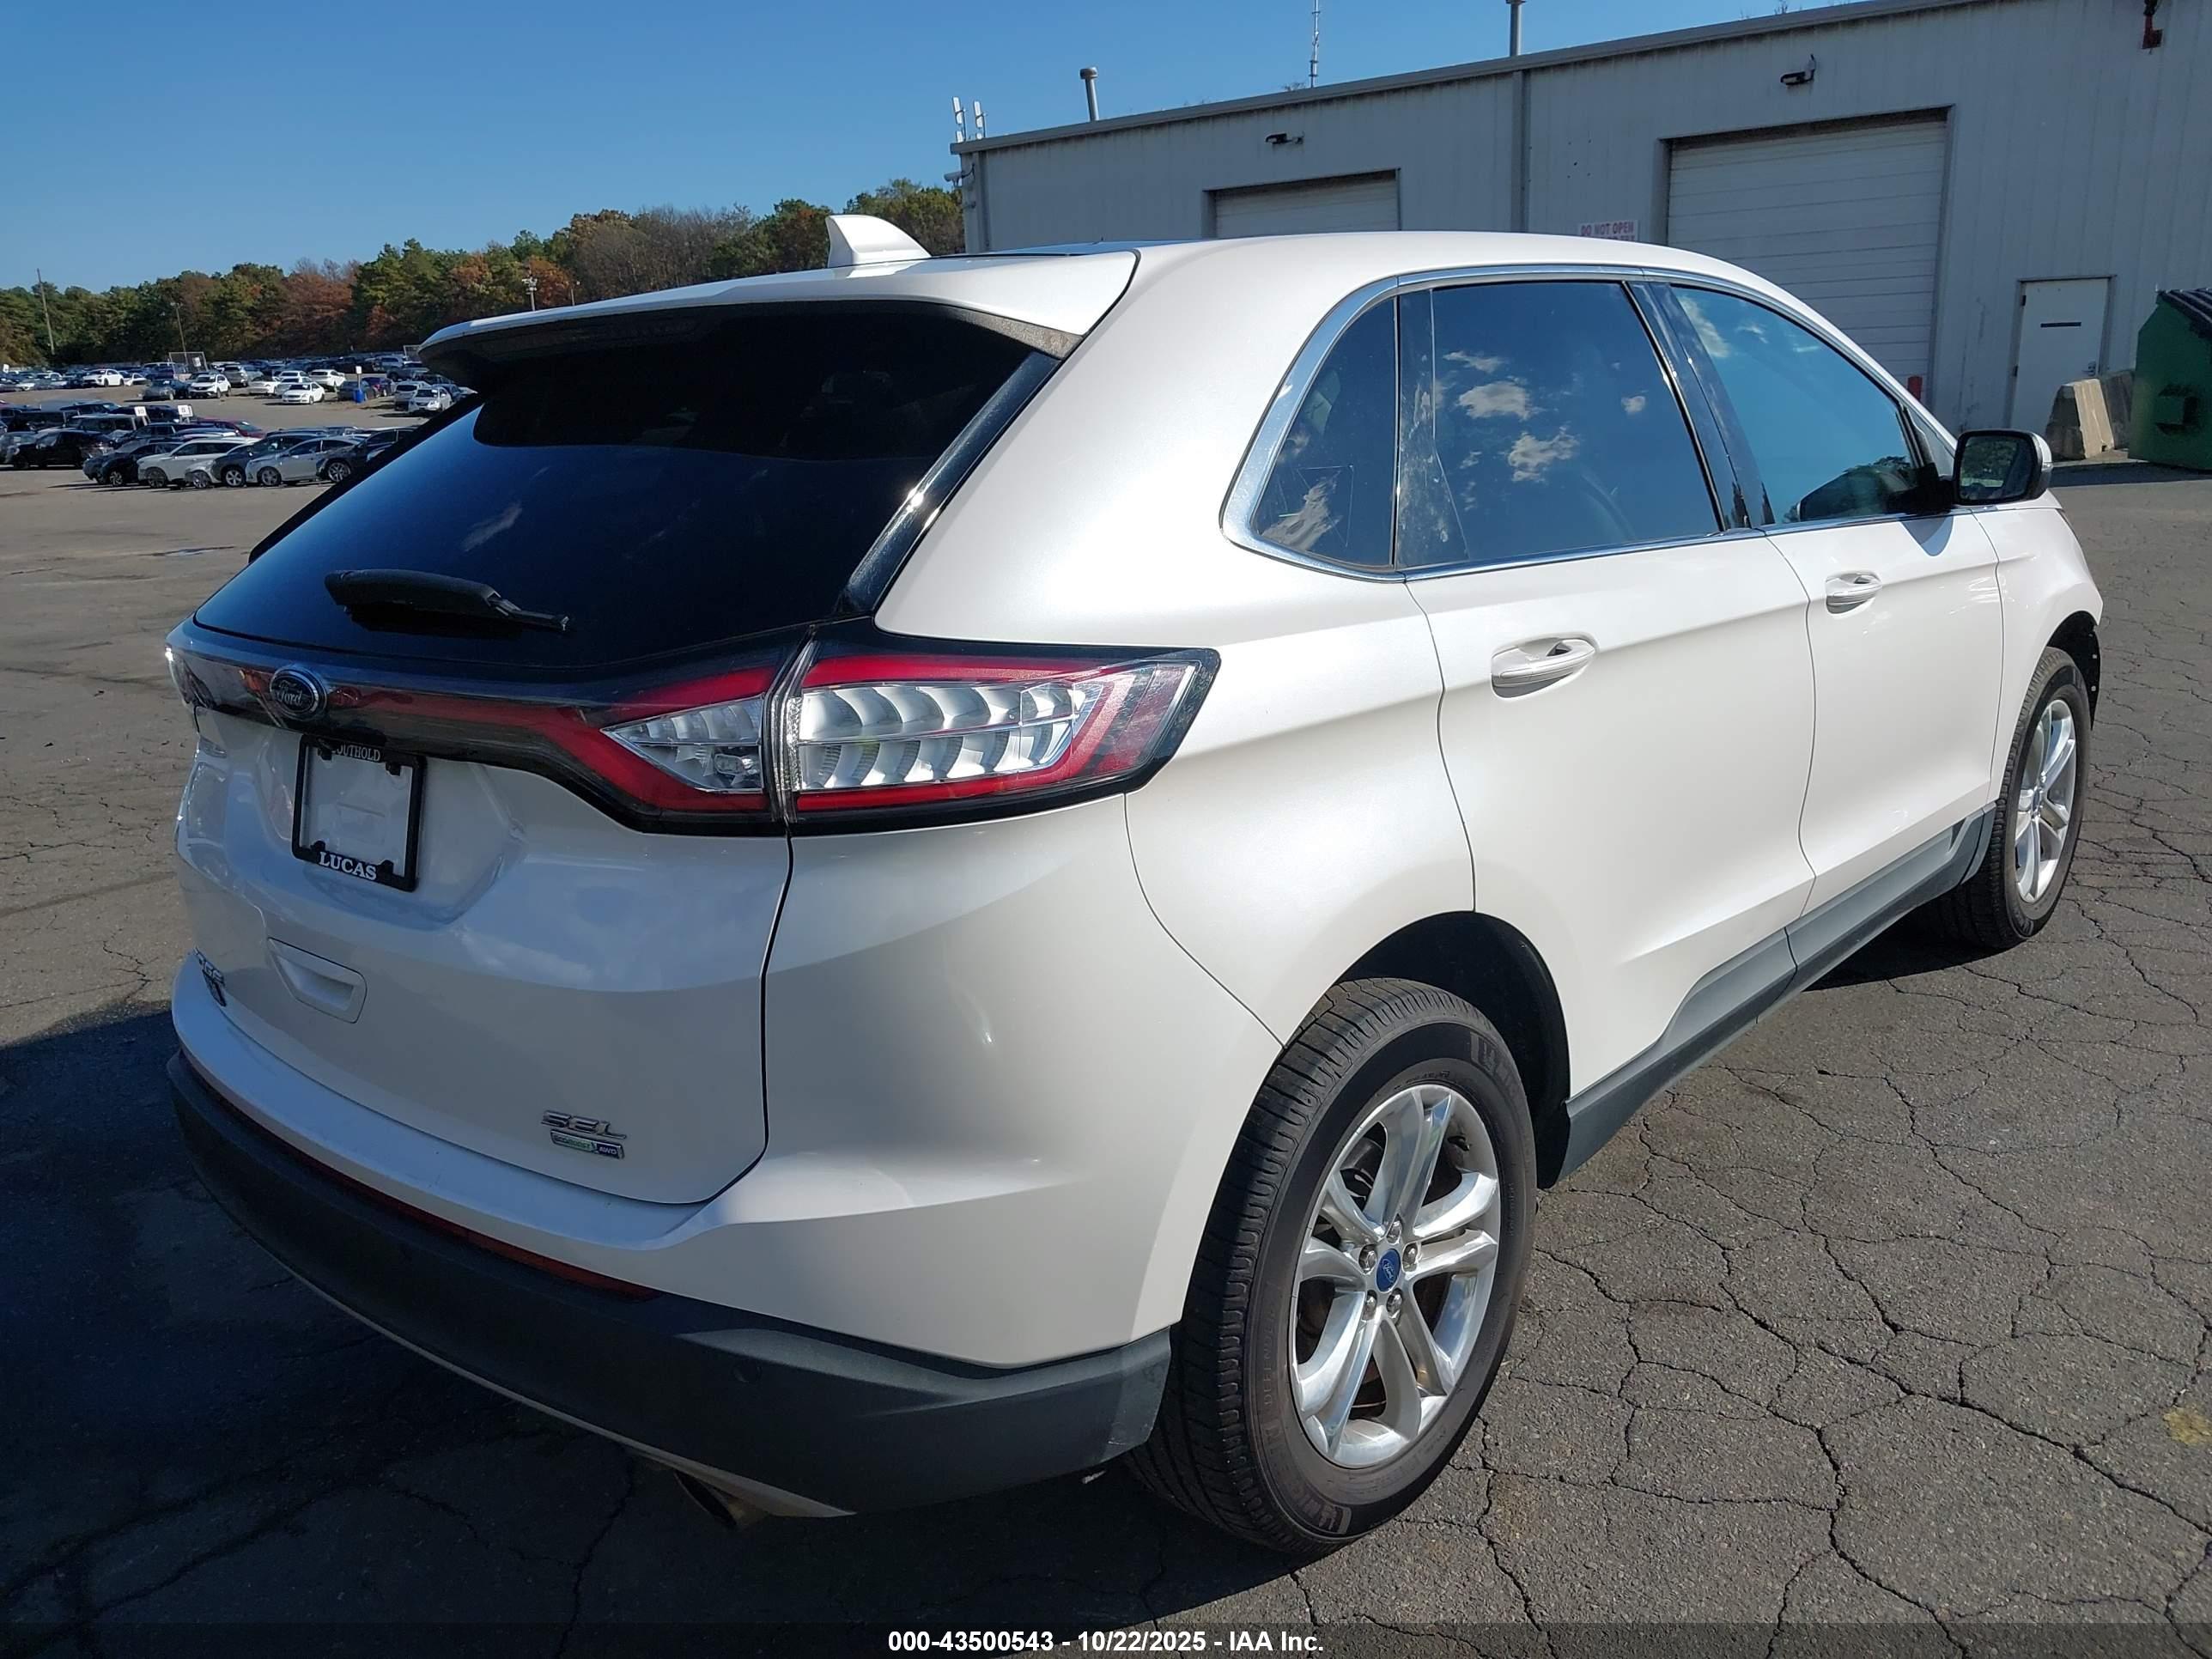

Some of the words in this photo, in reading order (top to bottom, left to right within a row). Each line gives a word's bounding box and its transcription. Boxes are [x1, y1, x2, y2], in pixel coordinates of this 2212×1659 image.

[1580, 224, 1592, 236] DO
[1595, 222, 1610, 235] NOT
[1613, 221, 1635, 234] OPEN
[274, 680, 303, 707] Ford
[319, 851, 376, 881] LUCAS
[540, 1109, 628, 1139] SEL
